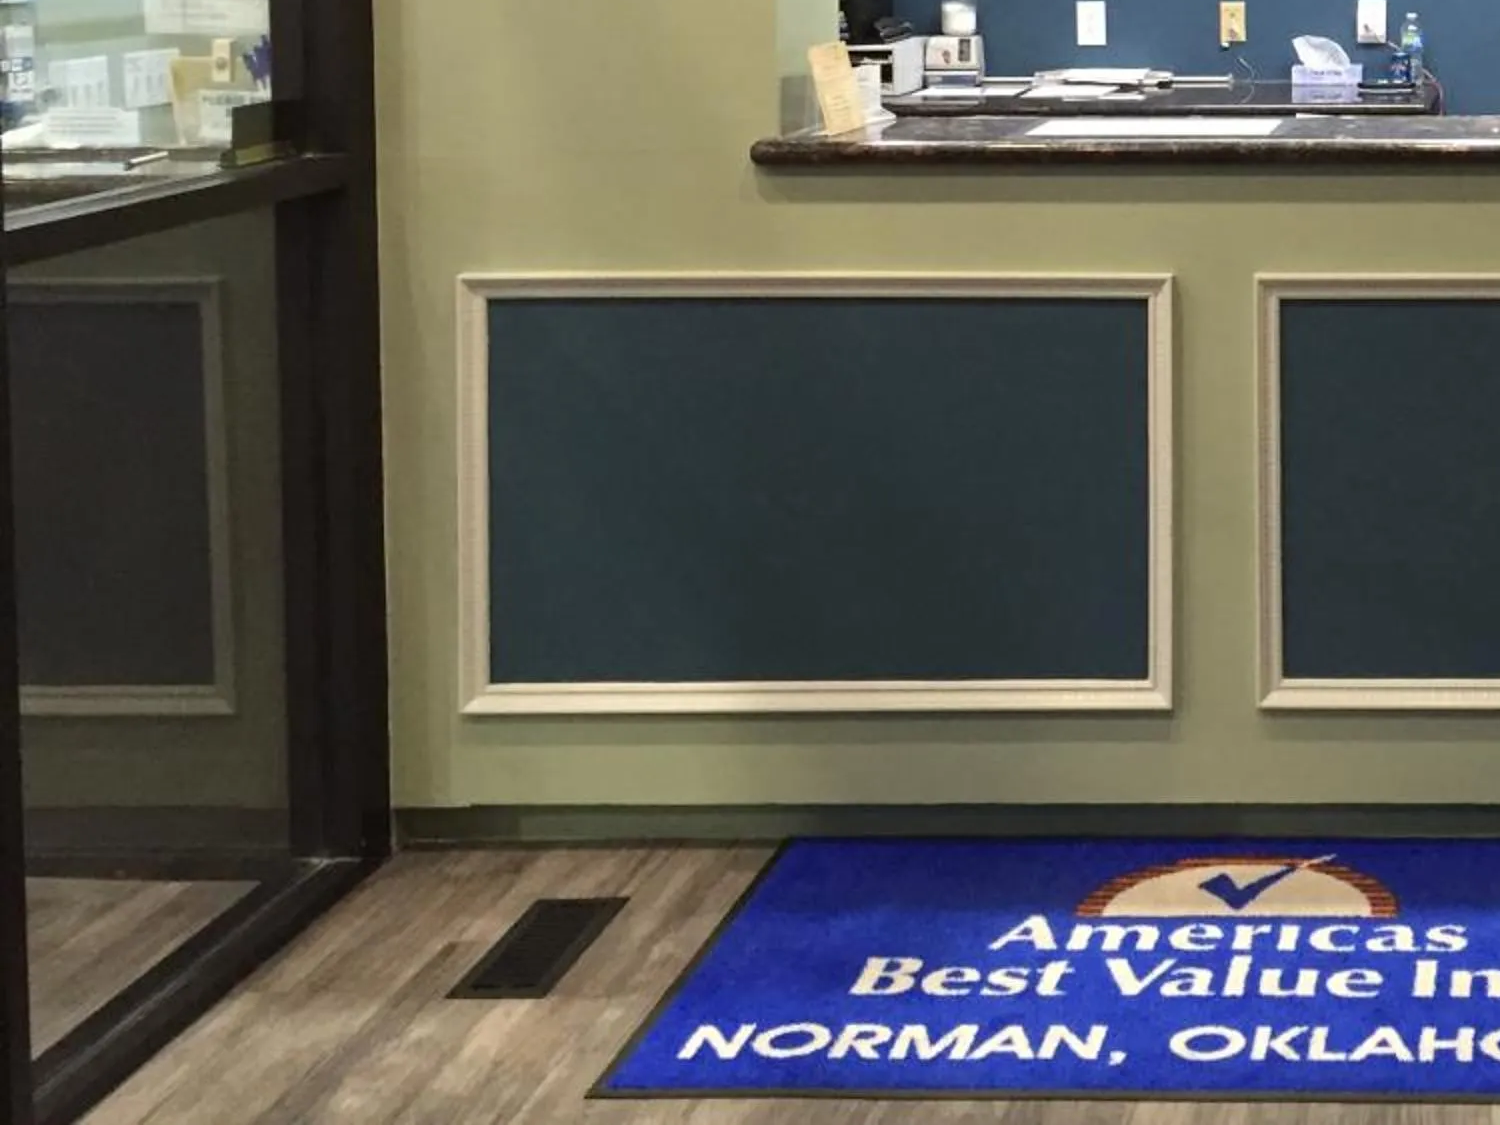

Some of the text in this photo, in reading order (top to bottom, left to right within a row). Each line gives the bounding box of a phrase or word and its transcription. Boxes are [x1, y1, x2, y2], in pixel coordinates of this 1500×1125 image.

[988, 914, 1468, 952] Americas
[849, 956, 1074, 997] Best
[1102, 955, 1384, 998] Value
[677, 1022, 1127, 1066] NORMAN,
